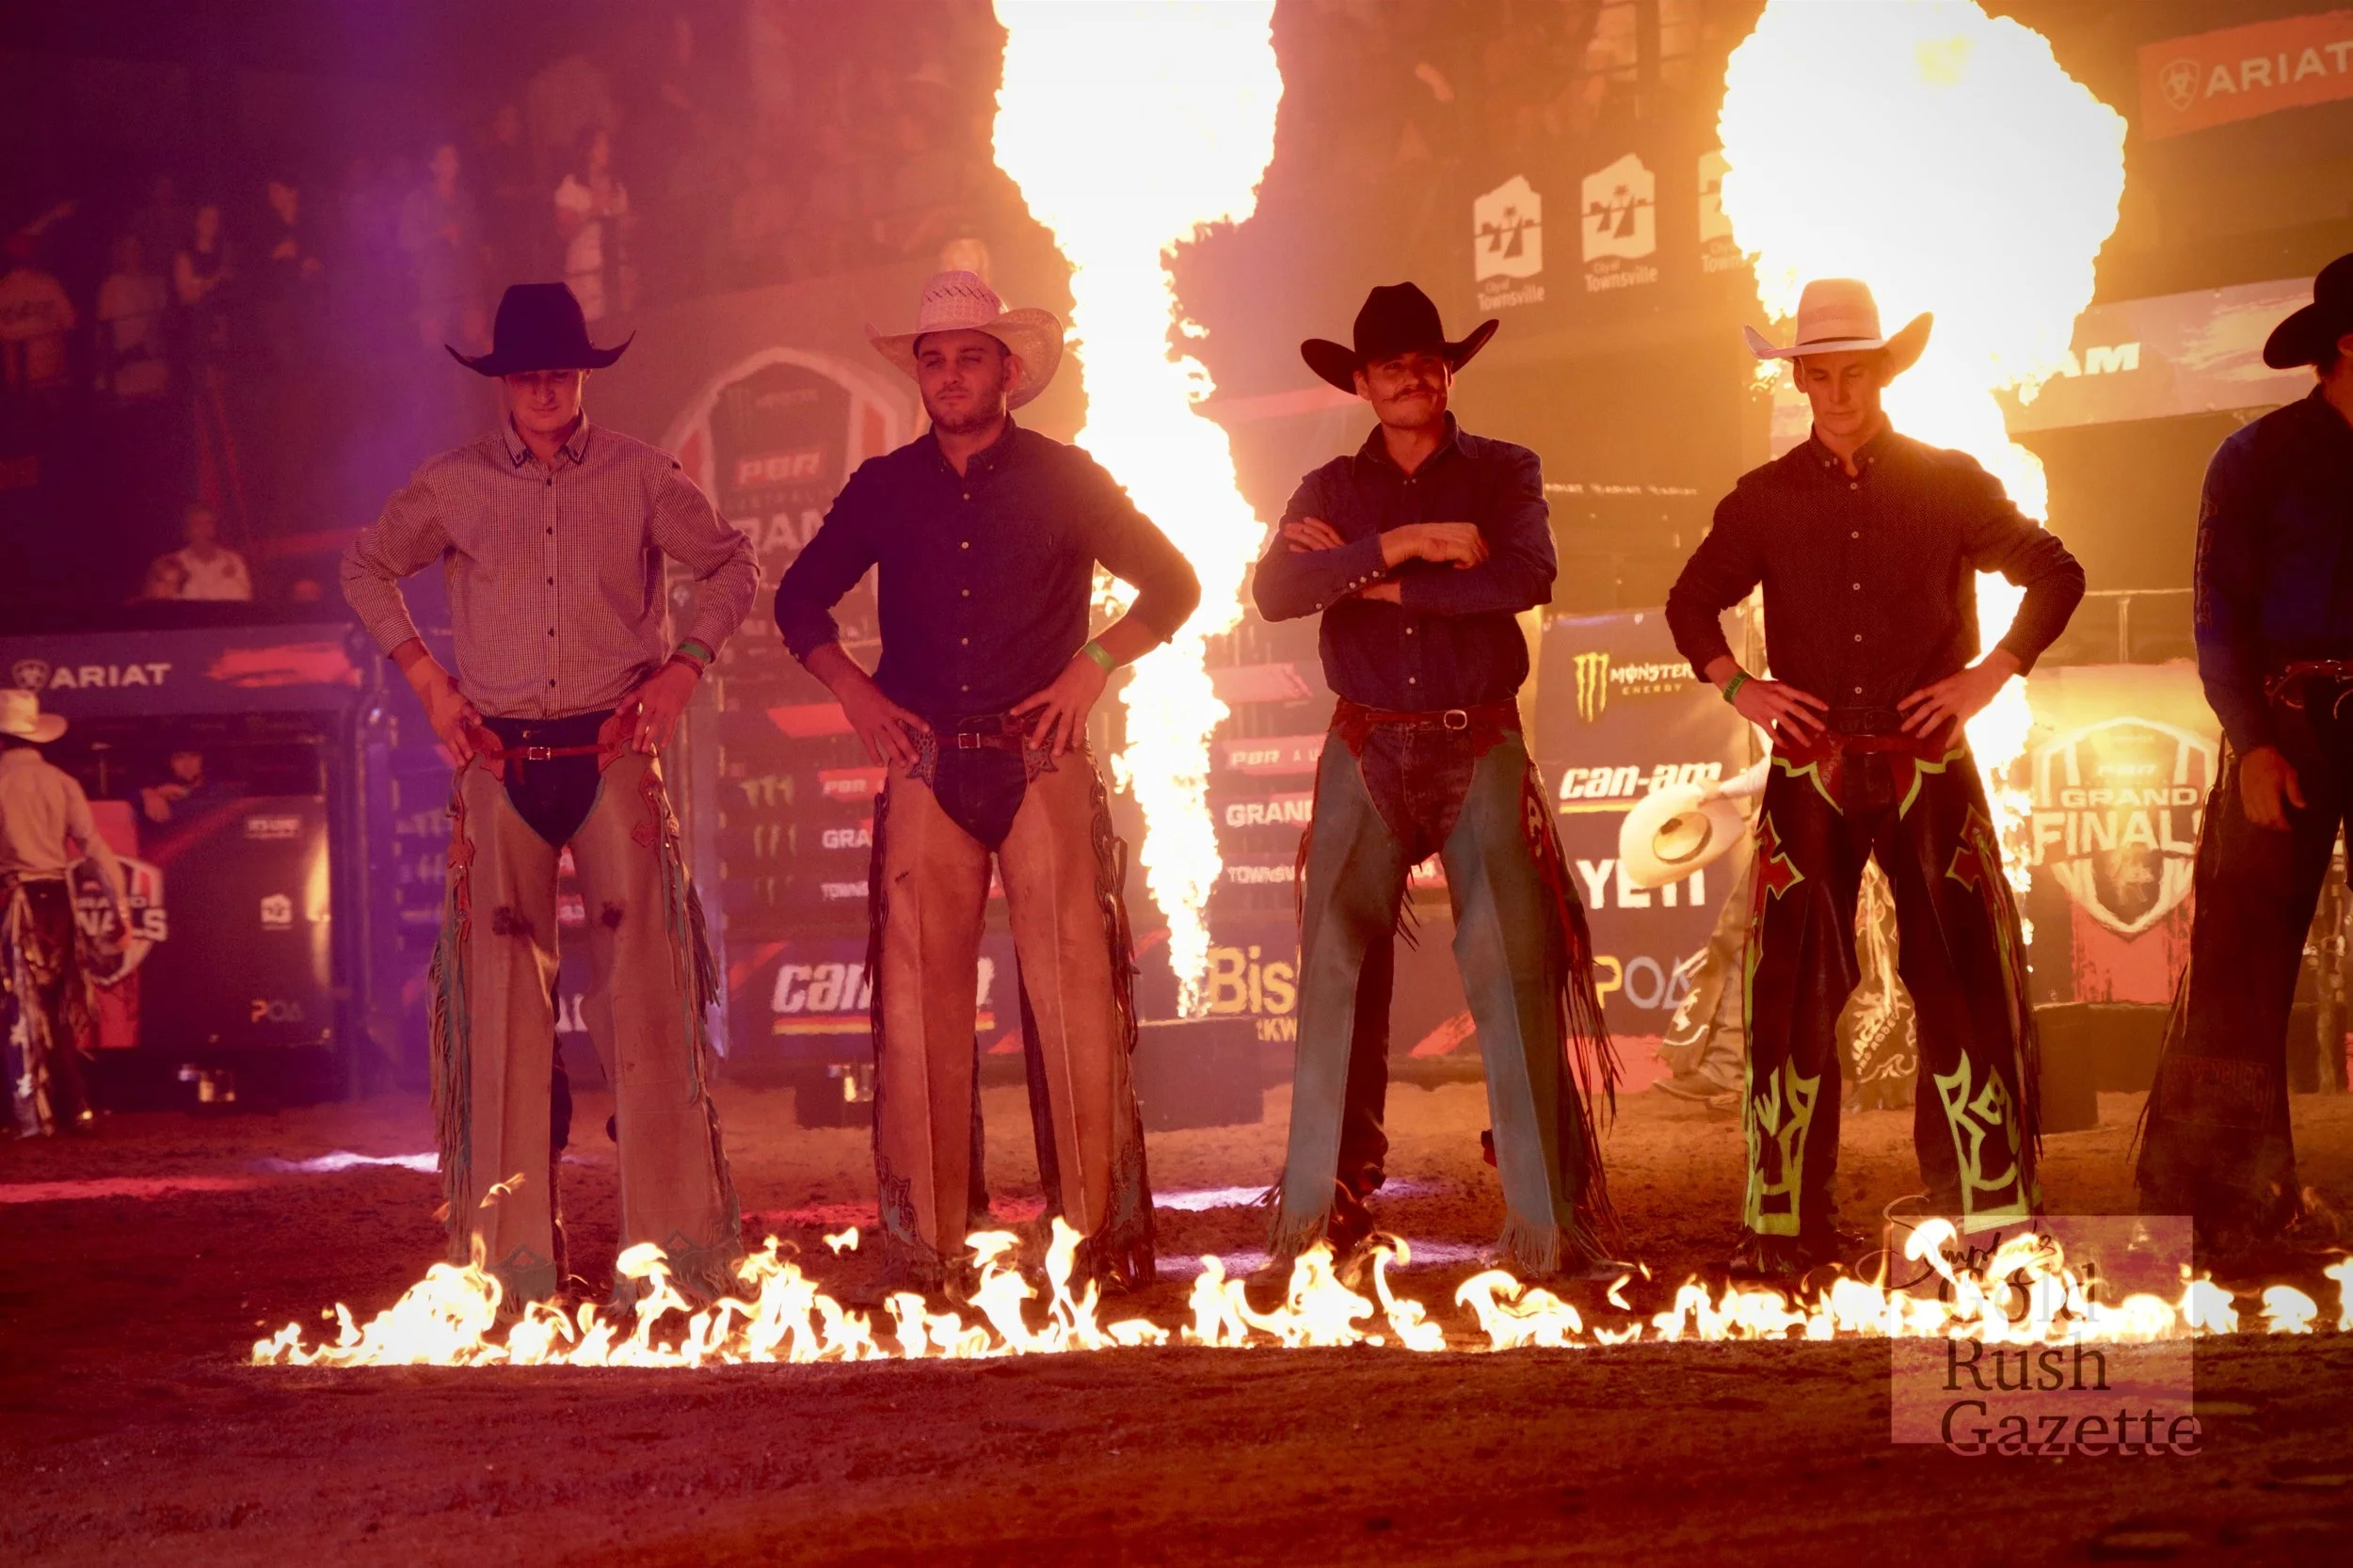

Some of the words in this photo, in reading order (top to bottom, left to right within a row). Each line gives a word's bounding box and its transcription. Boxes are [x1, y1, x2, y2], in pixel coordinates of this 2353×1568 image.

[2204, 40, 2353, 99] ARIAT
[1585, 264, 1658, 293] Townsville
[1477, 285, 1545, 312] Townsville
[50, 663, 171, 689] ARIAT
[1609, 663, 1695, 684] MONSTER
[2060, 787, 2198, 808] GRAND
[822, 828, 872, 849] GRA
[1207, 945, 1295, 1015] Bis
